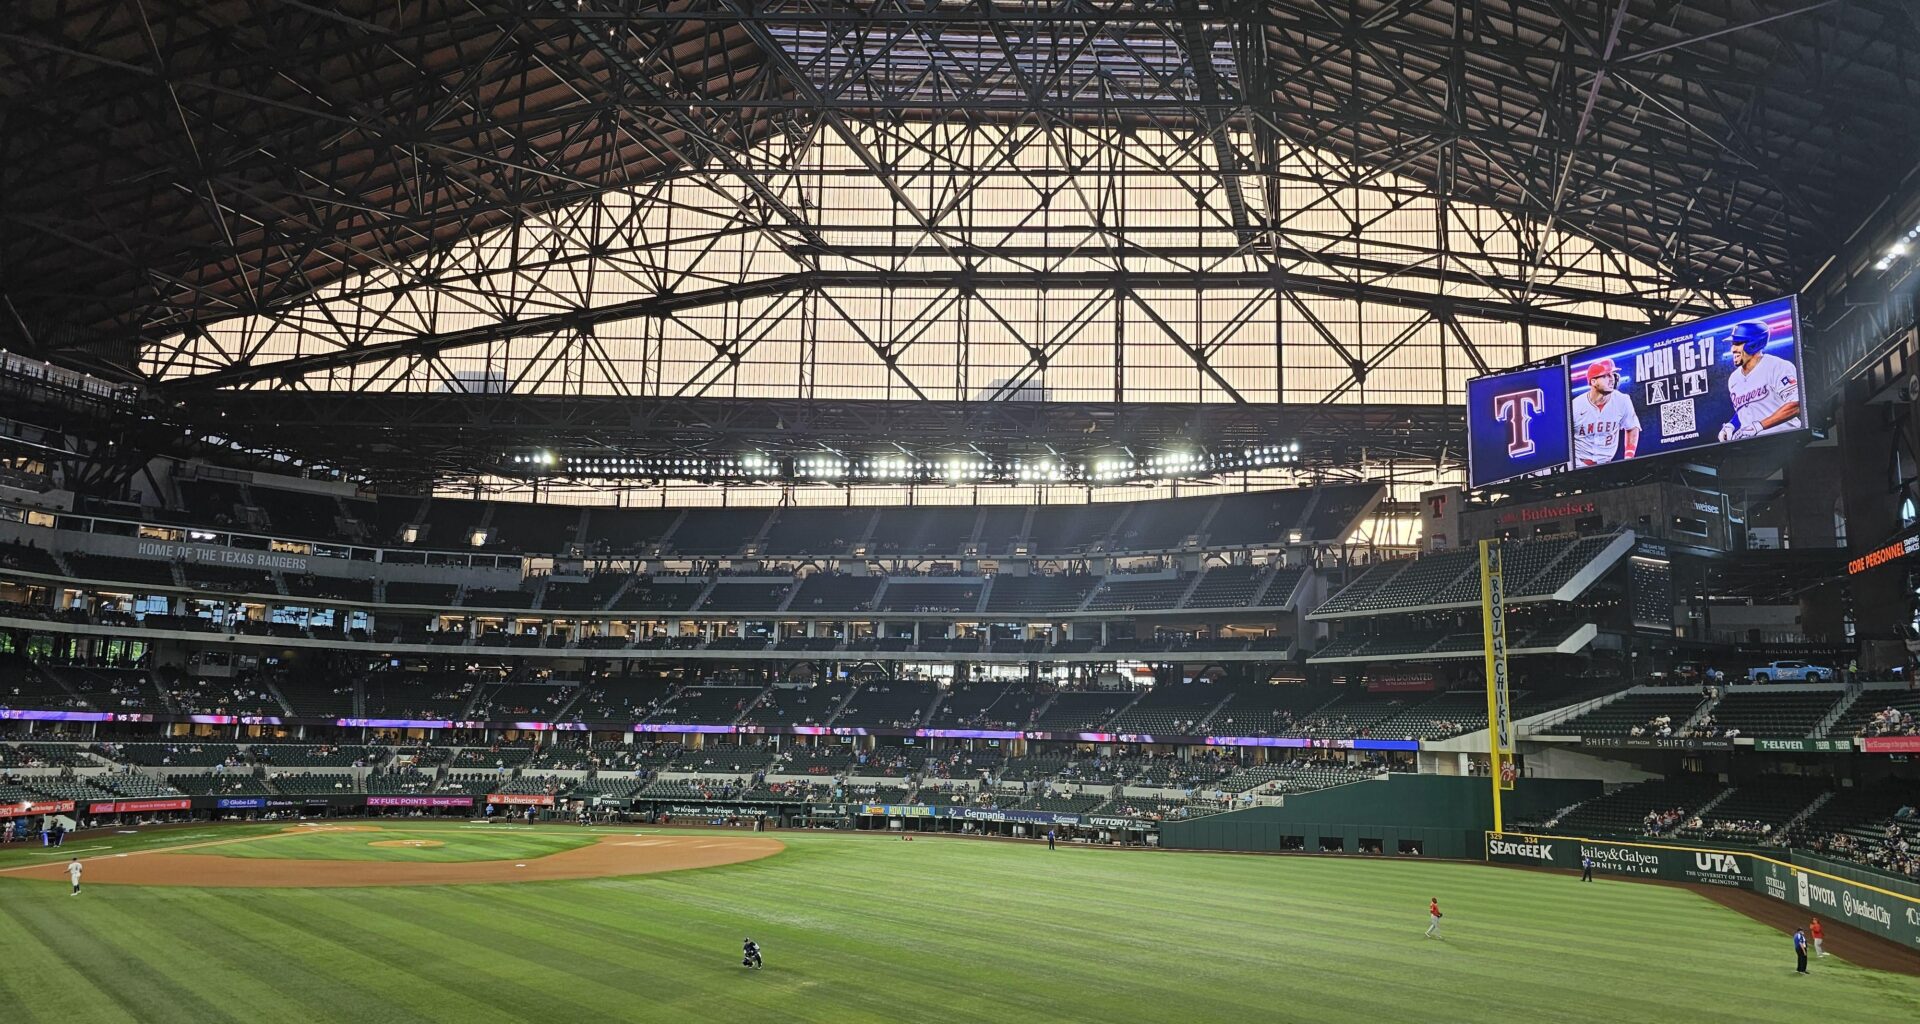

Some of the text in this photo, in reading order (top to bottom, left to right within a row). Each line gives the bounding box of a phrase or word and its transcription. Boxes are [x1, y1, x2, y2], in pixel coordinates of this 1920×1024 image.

[1634, 336, 1715, 382] APRIL 15-17
[1731, 384, 1769, 410] Rangers
[1494, 388, 1544, 459] T
[1660, 432, 1700, 444] rangers.com
[1520, 503, 1595, 522] Budweiser
[138, 542, 307, 570] HOME OF THE TEXAS RANGERS
[1848, 542, 1905, 574] CORE PERSONNEL
[1491, 578, 1502, 633] ROOT
[1495, 663, 1508, 747] CHIKIN
[1585, 738, 1612, 746] SHIFT
[1656, 739, 1685, 747] SHIFT
[1761, 740, 1803, 749] 7-ELEVEN
[503, 796, 539, 804] Budweiser
[681, 807, 768, 816] Kroger Kroger Kroger
[964, 809, 1006, 821] Germania
[1089, 817, 1131, 827] VICTORY
[1524, 836, 1538, 844] 334
[1489, 839, 1554, 861] SEATGEEK
[1640, 866, 1658, 874] LAW
[1695, 852, 1742, 874] UTA
[1765, 876, 1787, 891] ESTRELLA
[1767, 886, 1786, 900] JALISCO
[1808, 884, 1838, 908] TOYOTA
